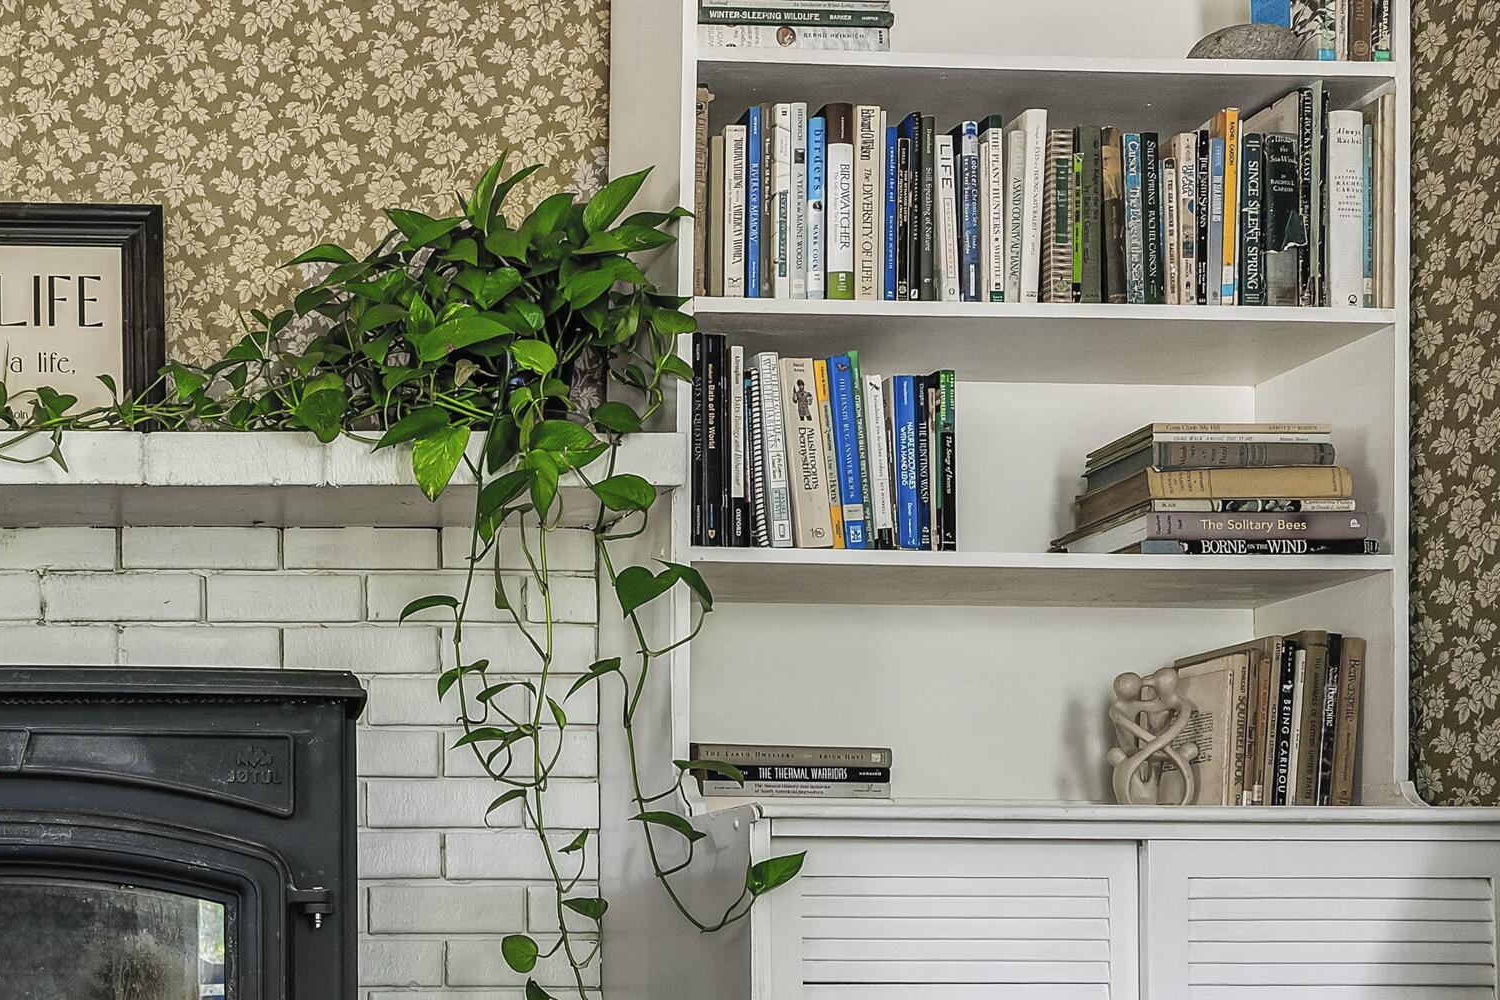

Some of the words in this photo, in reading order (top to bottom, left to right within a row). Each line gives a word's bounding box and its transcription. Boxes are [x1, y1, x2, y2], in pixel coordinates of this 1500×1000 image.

[991, 132, 999, 150] THE
[814, 130, 824, 191] birders
[940, 144, 952, 188] LIFE
[992, 154, 1000, 185] PLANT
[1128, 141, 1138, 176] Carson
[1248, 160, 1259, 196] SINCE
[840, 164, 850, 250] BIRDWATCHER
[862, 183, 873, 239] DIVERSITY
[925, 217, 932, 226] of
[992, 188, 1000, 235] HUNTERS
[862, 241, 872, 256] OF
[862, 259, 872, 282] LIFE
[1248, 246, 1259, 290] SPRING
[10, 356, 23, 373] a
[37, 352, 76, 375] life,
[708, 403, 715, 411] of
[919, 422, 927, 436] THE
[798, 427, 812, 490] Demystified
[806, 427, 820, 490] Mushrooms
[920, 480, 928, 503] WASP
[1201, 520, 1224, 530] The
[1228, 518, 1273, 532] Solitary
[1277, 520, 1307, 530] Bees
[1201, 539, 1247, 554] BORNE
[1268, 540, 1308, 554] WIND
[1282, 699, 1291, 734] BEING
[758, 768, 772, 779] THE
[774, 768, 809, 779] THERMAL
[812, 768, 848, 780] WARRIORS
[1234, 752, 1245, 786] BOOK
[1278, 740, 1288, 793] CARIBOU
